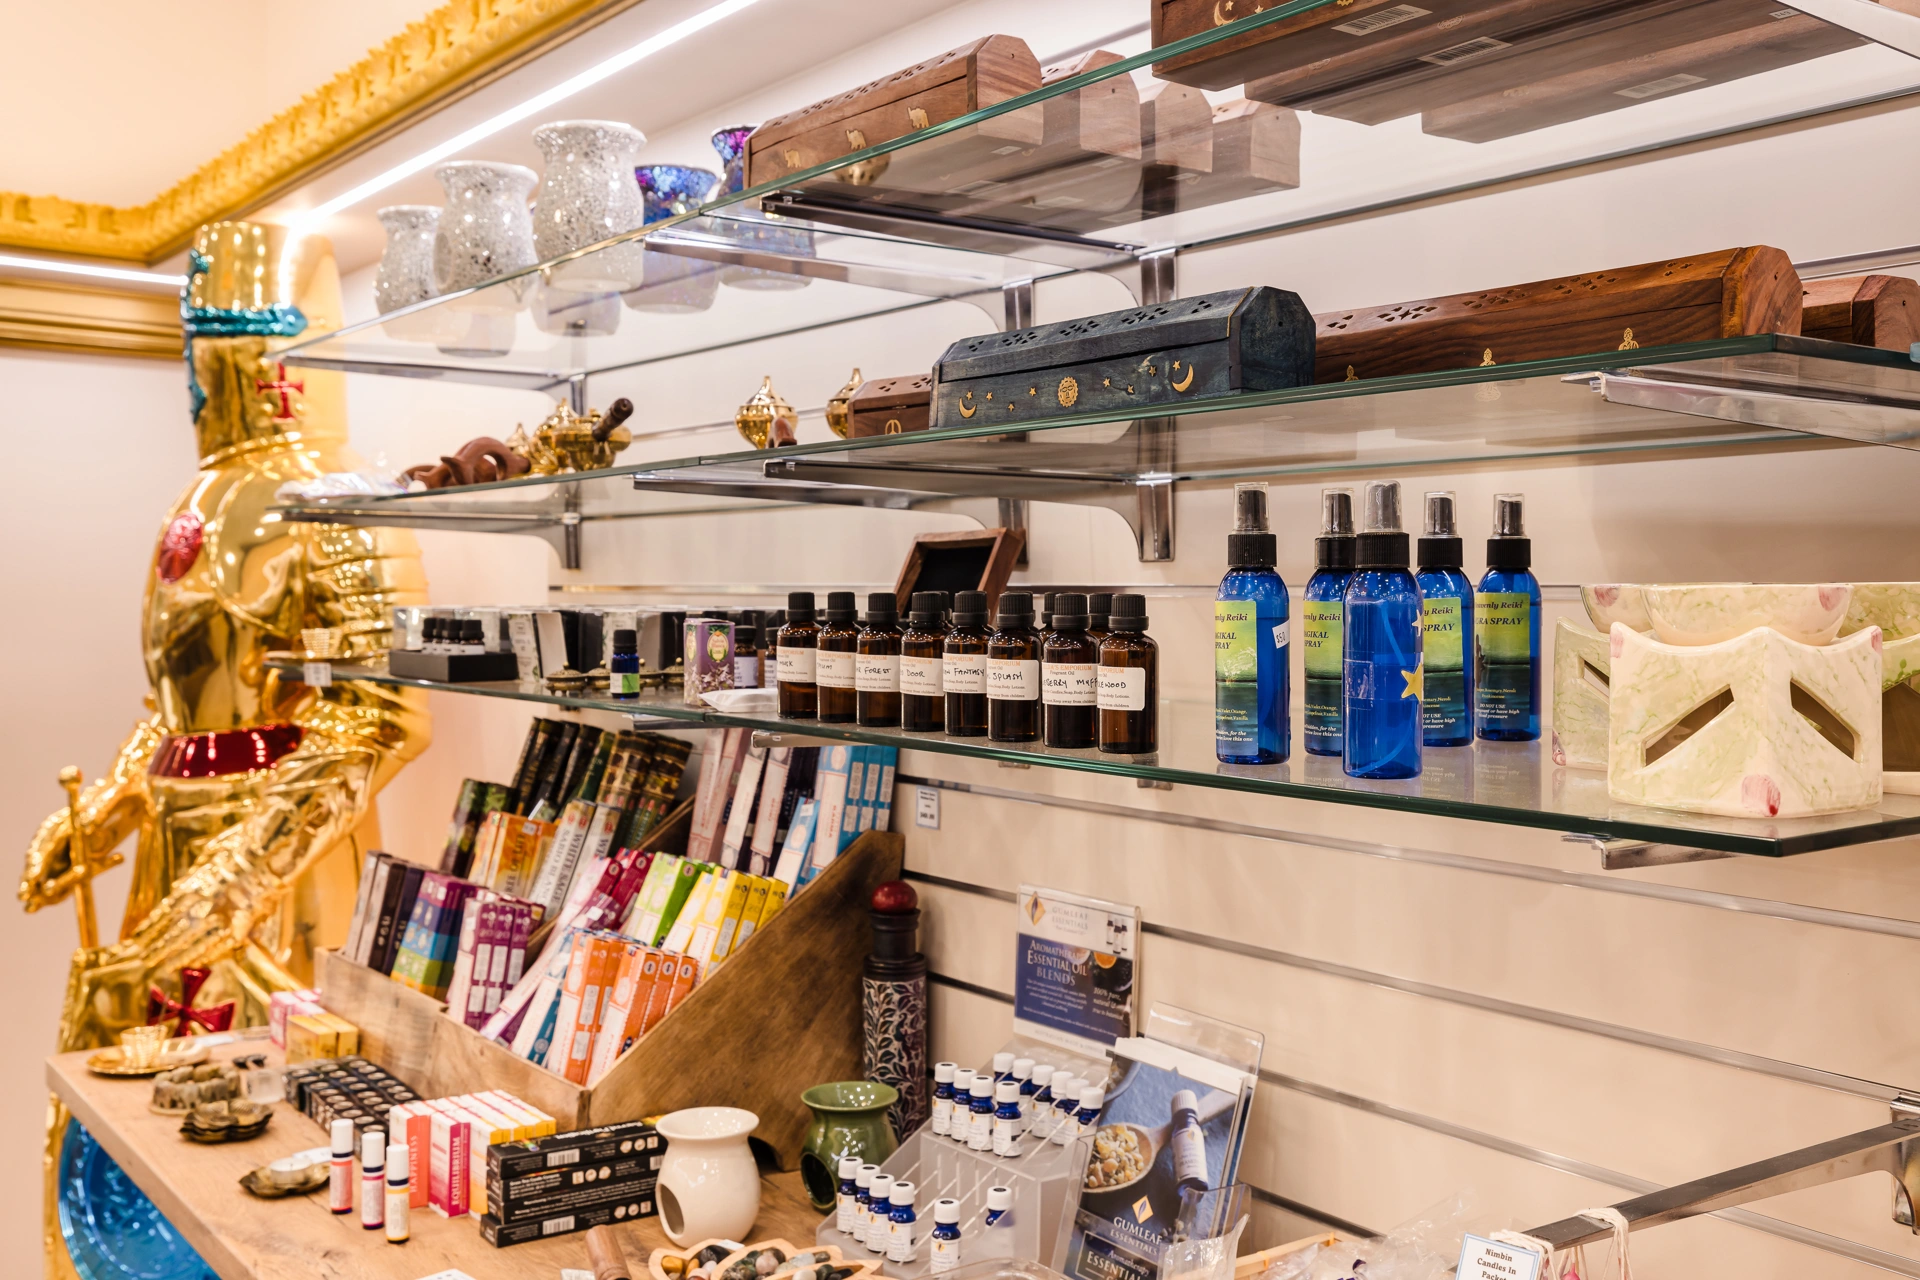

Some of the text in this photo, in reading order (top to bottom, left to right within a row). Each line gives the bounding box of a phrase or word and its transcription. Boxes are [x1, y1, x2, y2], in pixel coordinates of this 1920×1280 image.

[1431, 607, 1454, 615] Reiki
[1500, 601, 1523, 609] Reiki
[1226, 613, 1248, 621] Reiki
[1318, 613, 1341, 621] Reiki
[1489, 617, 1524, 625] SPRAY
[864, 666, 892, 675] FOREST
[906, 669, 926, 678] DOOR
[954, 666, 985, 677] FANTASY
[992, 671, 1023, 681] SPLASH
[1027, 949, 1088, 977] ESSENTIAL OIL
[1036, 966, 1076, 987] BLENDS
[409, 1134, 418, 1194] HAPPINESS
[451, 1136, 461, 1206] EQUILIBRIUM
[1113, 1216, 1163, 1245] GUMLEAF
[1110, 1229, 1158, 1256] ESSENTIALS
[1485, 1248, 1513, 1262] Nimbin
[1107, 1249, 1150, 1278] Aromatherapy
[1477, 1257, 1517, 1276] Candles In
